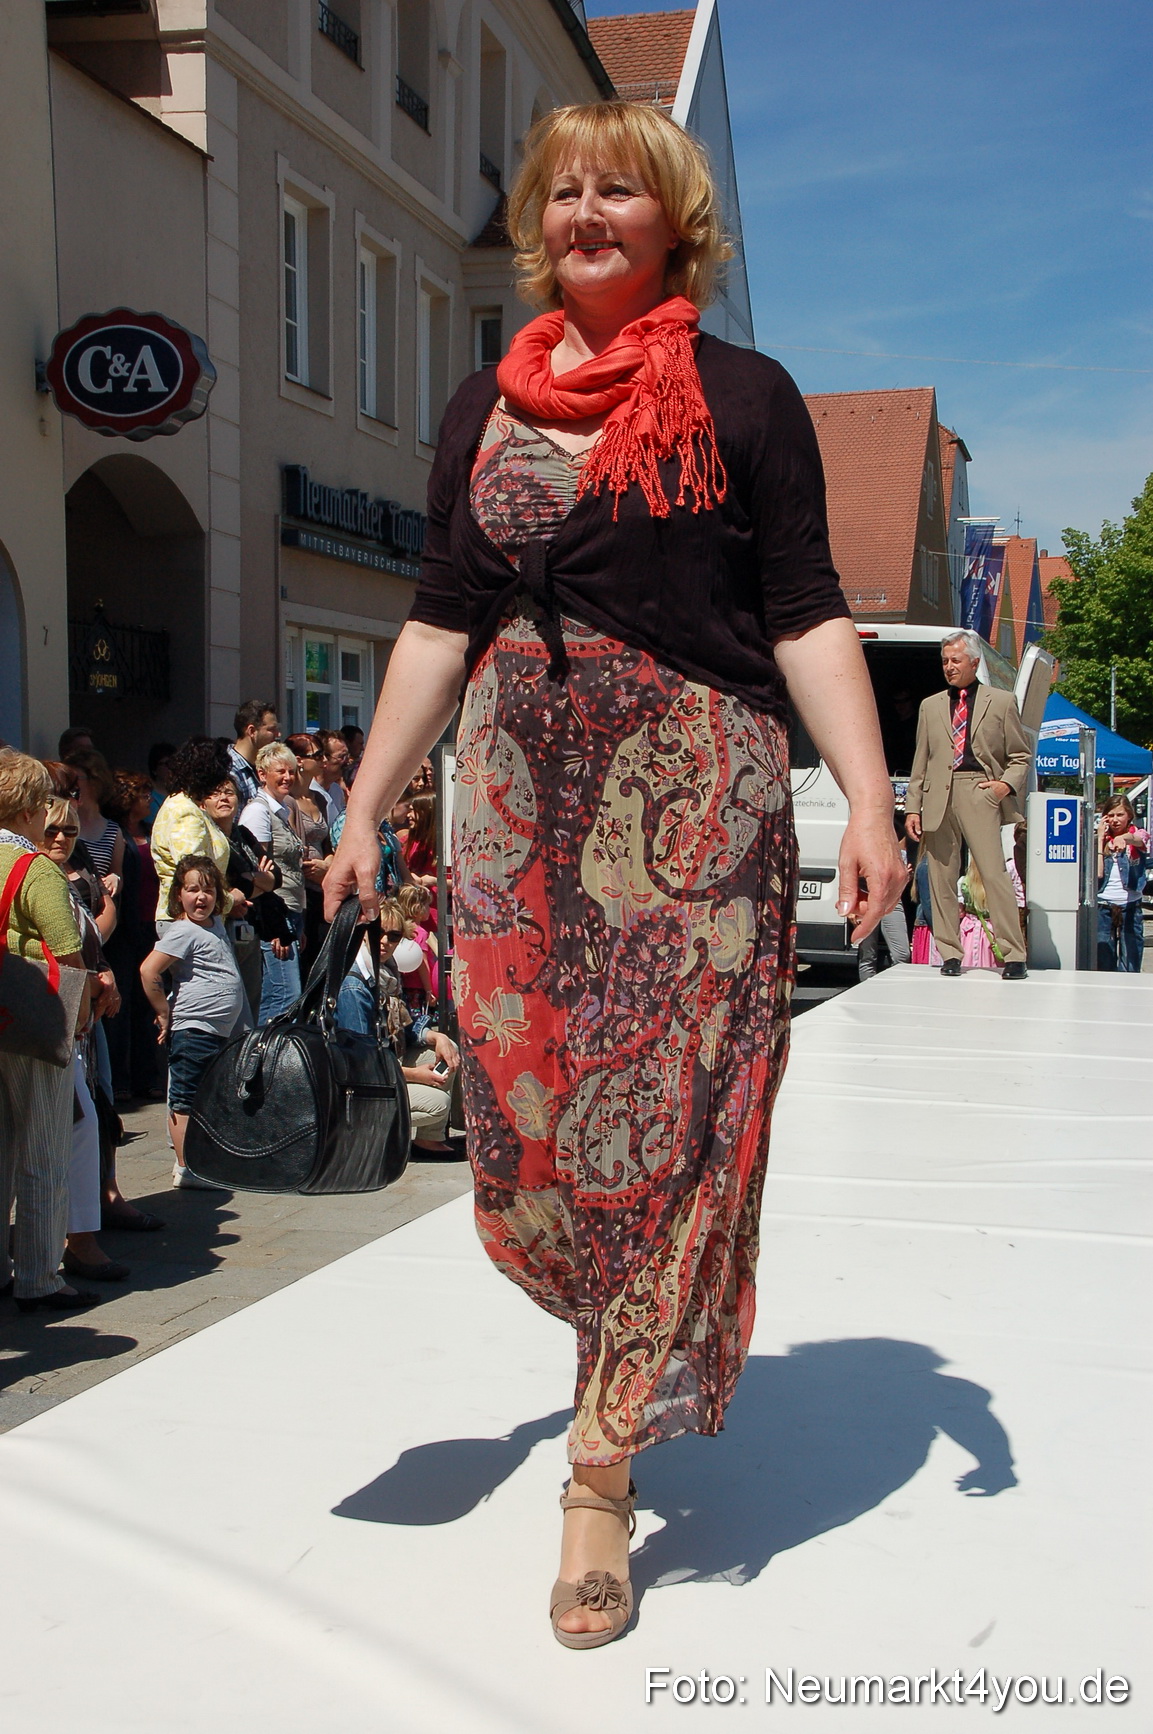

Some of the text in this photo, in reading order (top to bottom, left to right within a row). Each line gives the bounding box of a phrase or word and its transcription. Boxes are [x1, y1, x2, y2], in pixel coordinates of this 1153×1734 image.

[78, 345, 169, 393] C&A
[299, 466, 384, 540] Neumarkter
[300, 533, 396, 572] MITTELBAYERISCHE
[1036, 754, 1106, 769] kter Tagtt
[1053, 807, 1072, 837] P
[801, 882, 817, 894] 60
